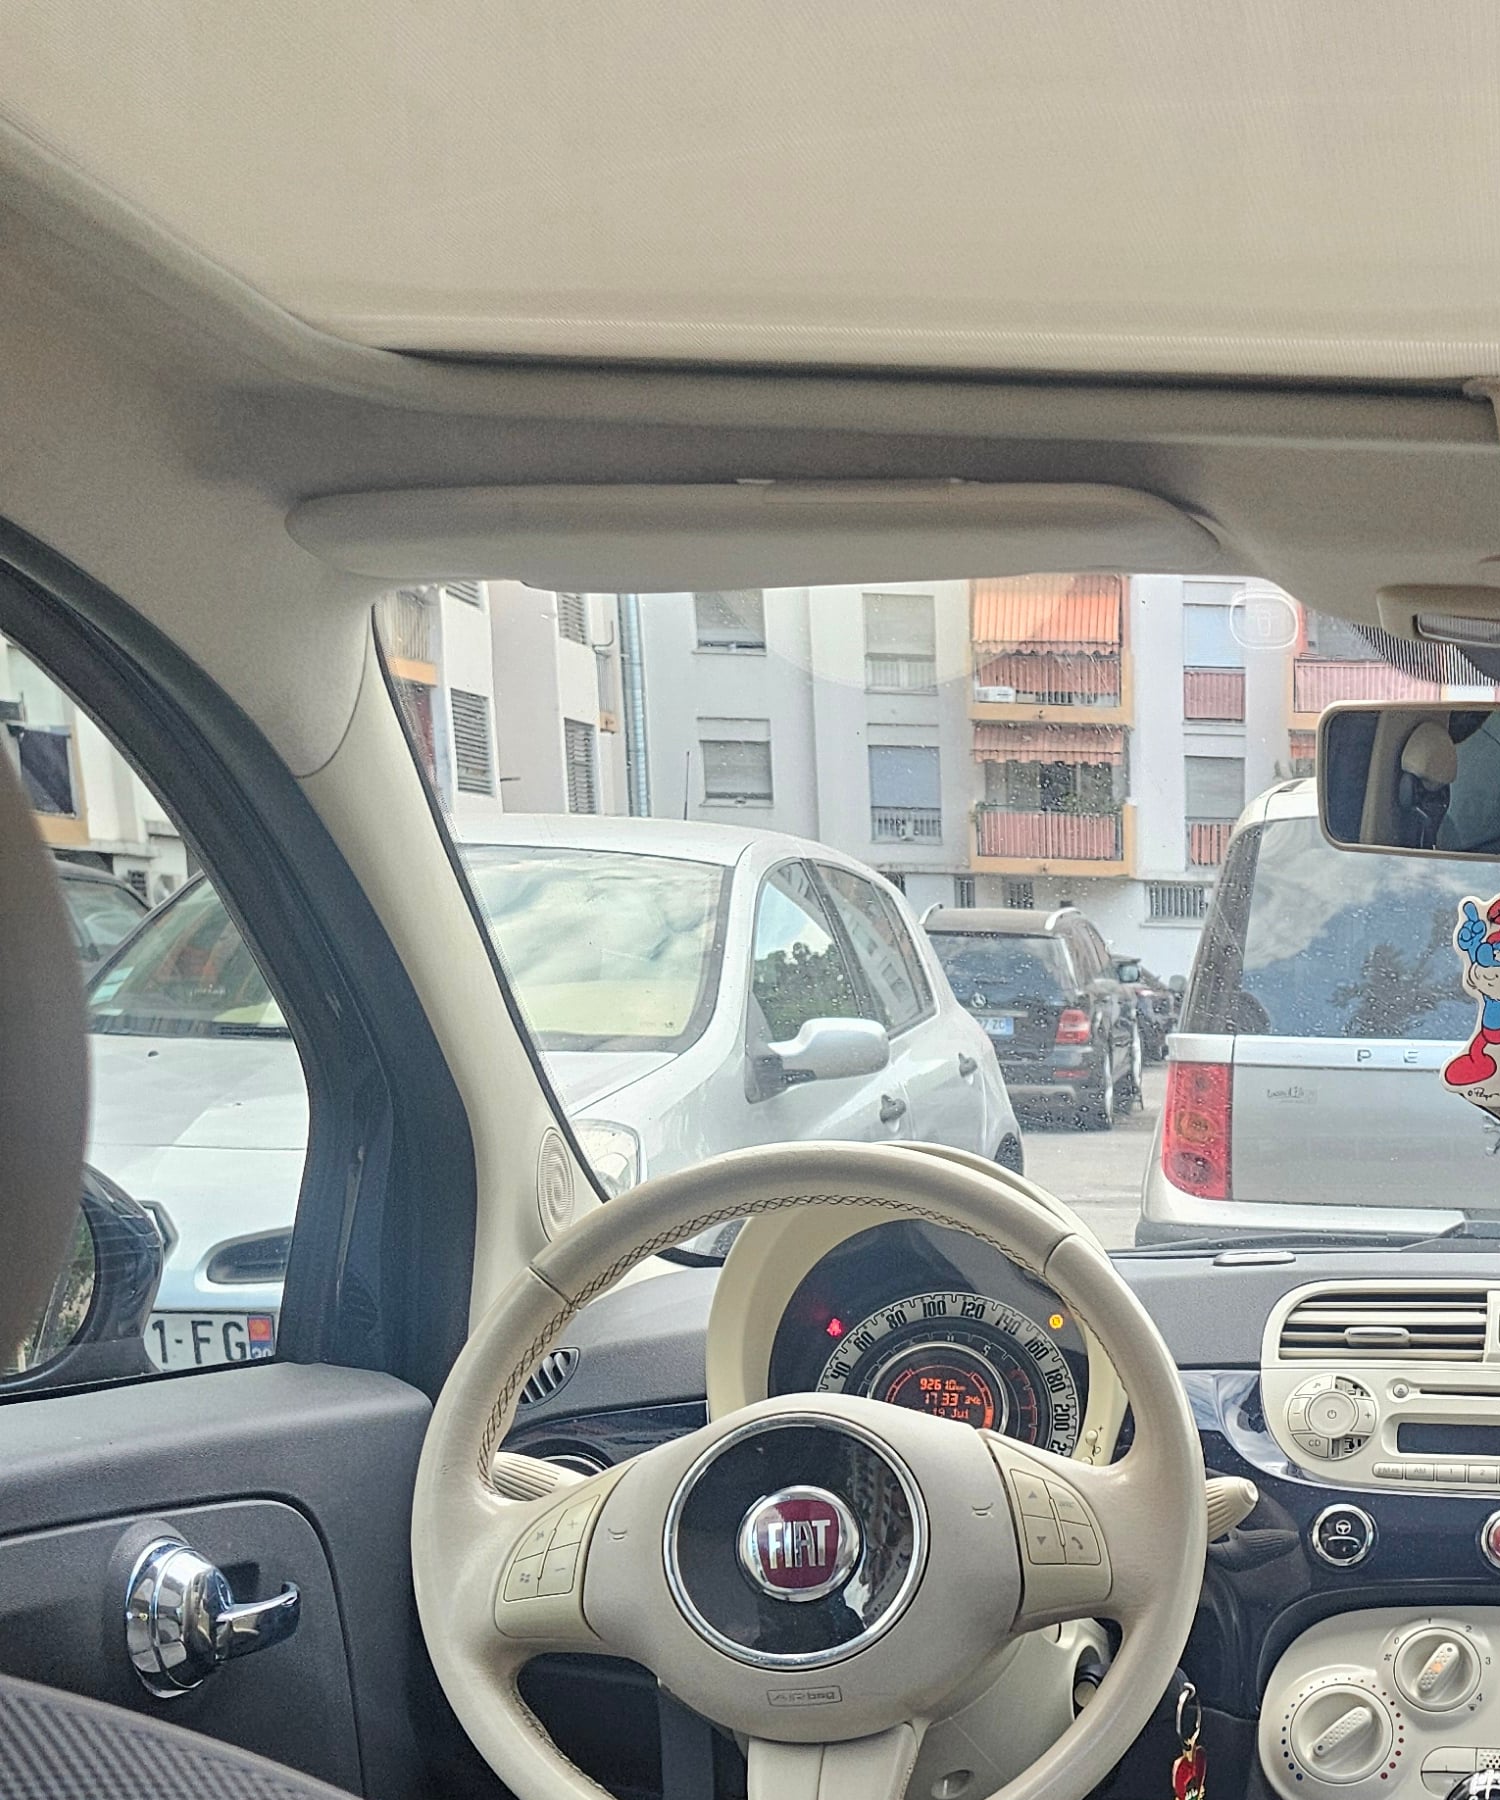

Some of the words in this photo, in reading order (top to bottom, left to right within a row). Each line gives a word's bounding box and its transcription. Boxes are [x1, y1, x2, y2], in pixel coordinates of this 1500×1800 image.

[885, 1309, 908, 1330] 80
[922, 1300, 947, 1318] 100
[960, 1301, 985, 1320] 120
[995, 1312, 1023, 1336] 140
[853, 1330, 876, 1352] 60
[1024, 1336, 1050, 1362] 160
[830, 1361, 851, 1380] 40
[1044, 1368, 1067, 1394] 180
[1053, 1403, 1071, 1432] 200
[1308, 1439, 1321, 1447] CD
[767, 1519, 832, 1570] FIAT
